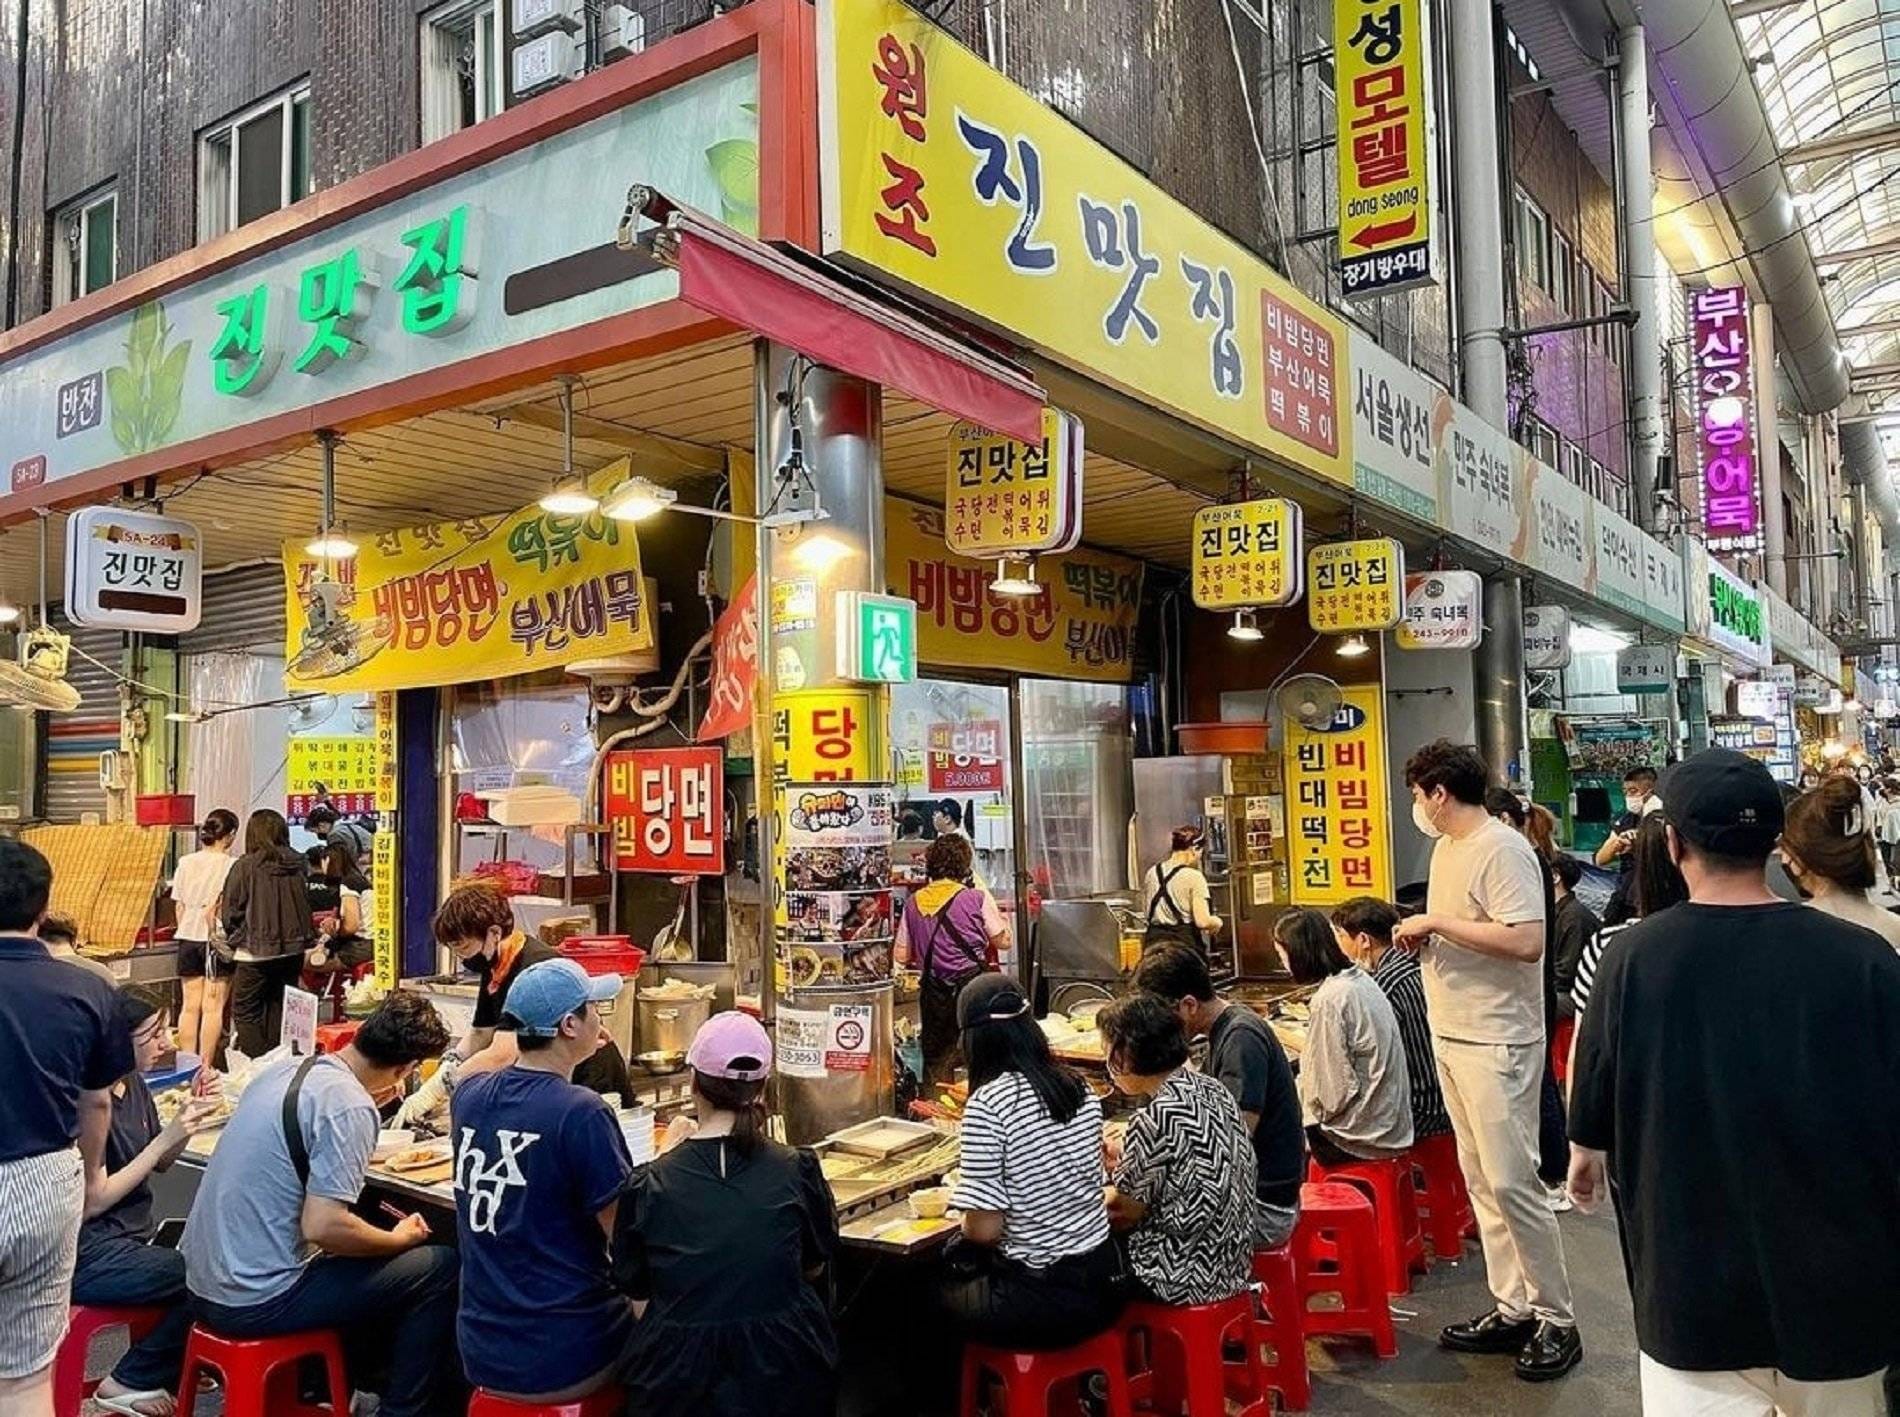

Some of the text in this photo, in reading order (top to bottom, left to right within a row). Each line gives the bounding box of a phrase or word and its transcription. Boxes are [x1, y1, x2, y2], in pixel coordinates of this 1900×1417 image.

[1348, 0, 1402, 66] 성
[872, 33, 937, 258] 원조
[1350, 65, 1410, 189] 모텔
[1347, 186, 1419, 218] dong seong
[955, 105, 1245, 398] 진맛집
[1343, 247, 1427, 287] 장기방우대
[210, 203, 468, 397] 진맛집
[1267, 303, 1329, 368] 비빔당면
[62, 377, 98, 432] 반찬
[1268, 344, 1331, 407] 부산어묵
[1270, 387, 1332, 446] 떡볶이
[1356, 367, 1431, 468] 서울생선
[102, 550, 184, 592] 진맛집
[1201, 520, 1279, 559] 진맛집
[1316, 557, 1387, 590] 진맛집
[372, 559, 500, 651] 비빔당면
[510, 569, 642, 656] 부산어묵
[611, 760, 636, 858] 비빔
[641, 762, 714, 855] 당면
[1333, 740, 1374, 889] 비빔당면
